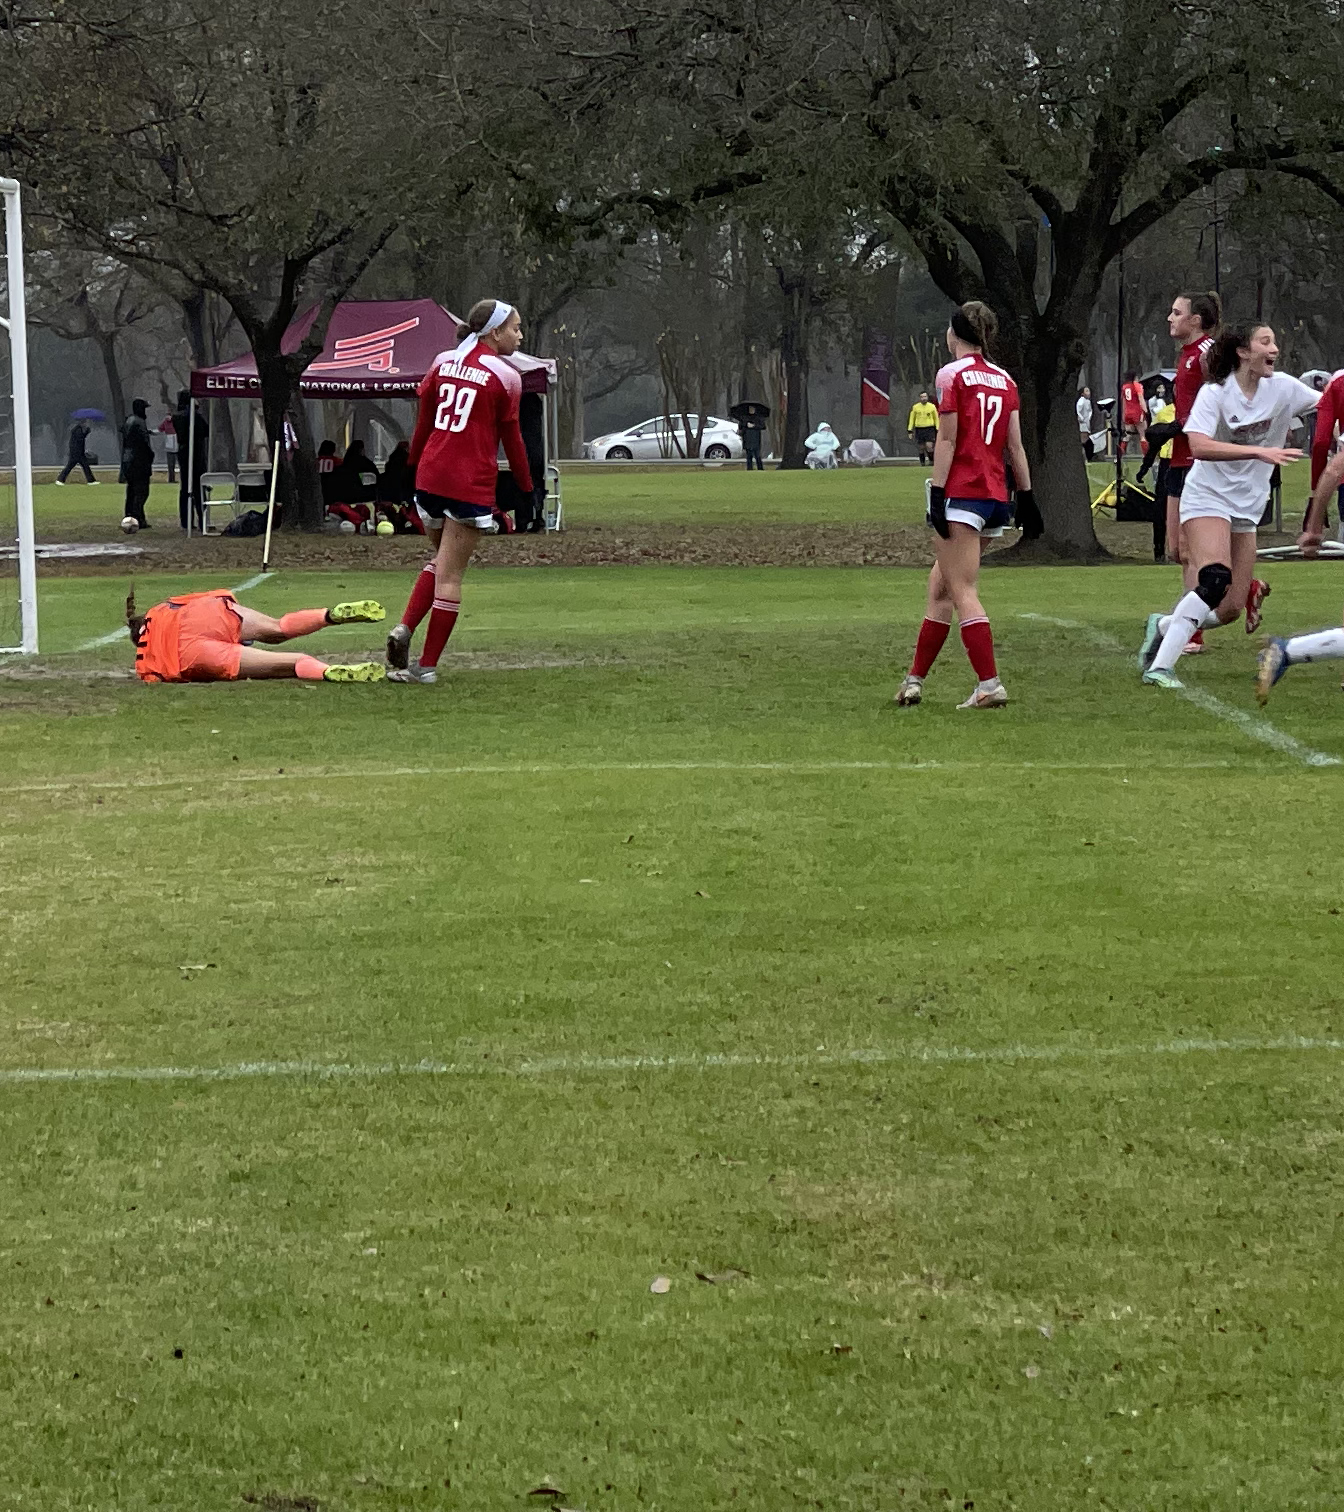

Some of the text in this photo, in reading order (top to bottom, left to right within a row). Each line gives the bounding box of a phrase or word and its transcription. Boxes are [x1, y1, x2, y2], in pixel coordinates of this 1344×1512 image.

[206, 376, 245, 389] ELITE
[439, 363, 491, 386] CHALLENGE
[299, 381, 421, 392] NATIONAL LEAGU
[435, 383, 477, 432] 29
[976, 392, 1003, 445] 17
[319, 459, 334, 473] 10
